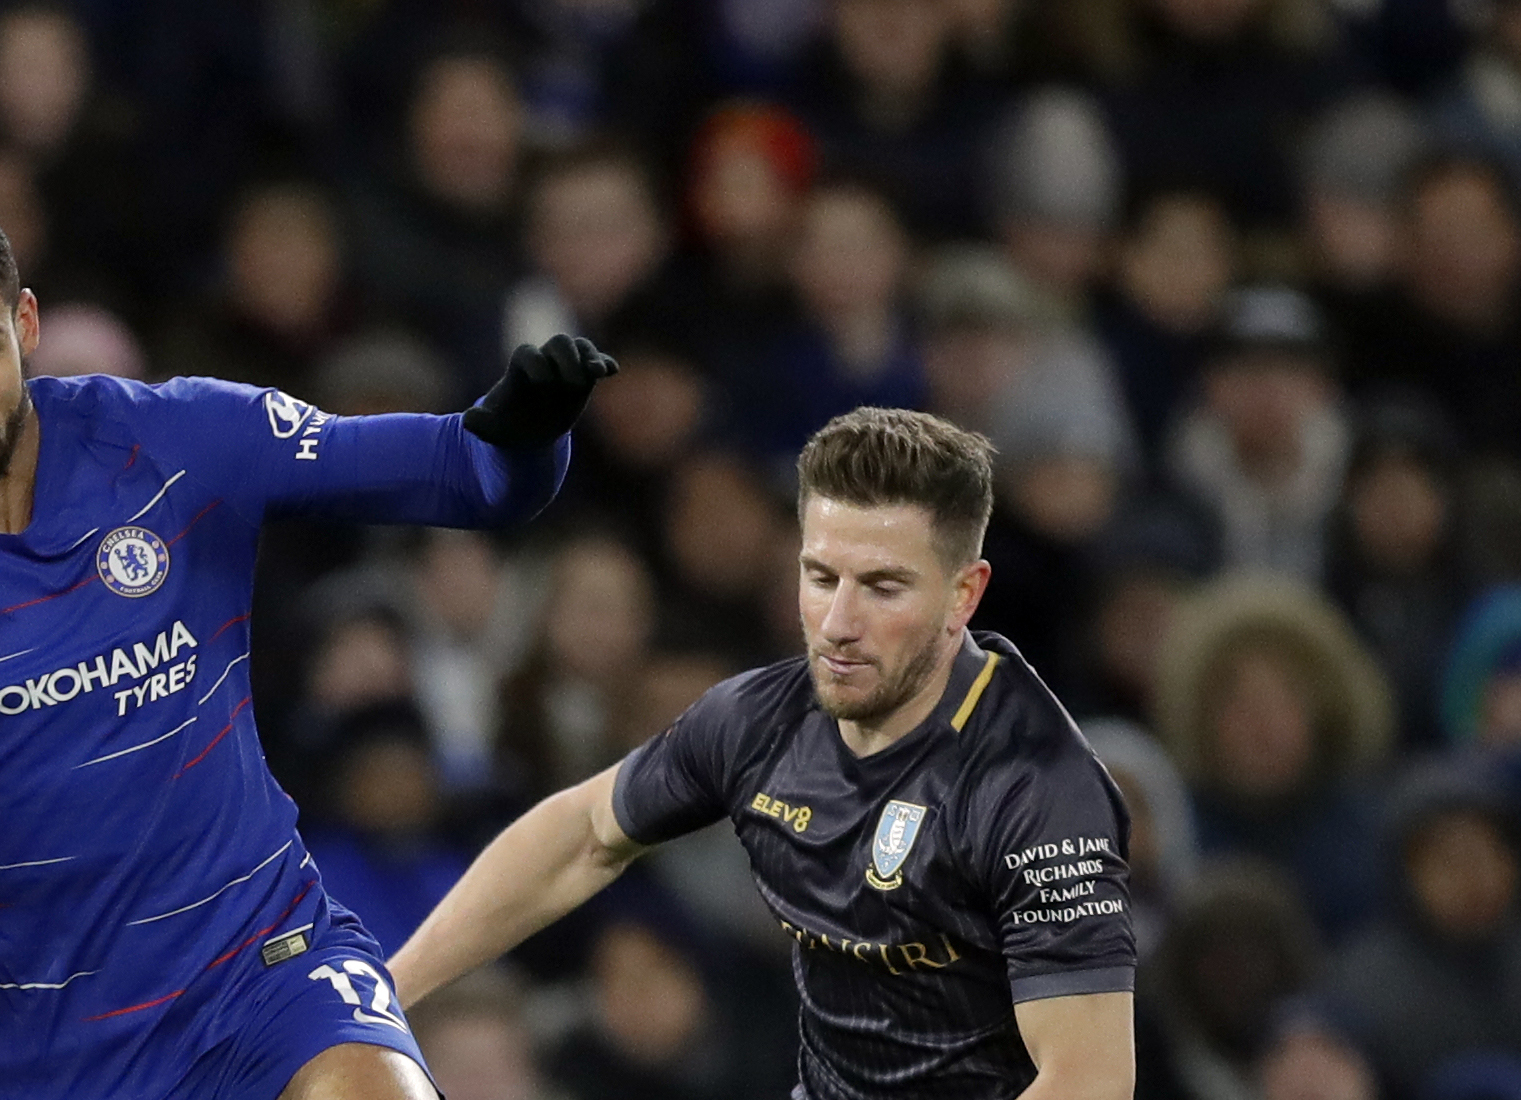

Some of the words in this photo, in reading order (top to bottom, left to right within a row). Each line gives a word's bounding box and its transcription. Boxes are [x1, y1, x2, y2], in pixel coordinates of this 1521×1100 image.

[102, 529, 144, 553] CHELSEA
[114, 654, 197, 717] TYRES
[751, 792, 812, 833] ELEV8
[1004, 843, 1059, 871] DAVID
[1061, 838, 1076, 856] &
[1078, 836, 1110, 857] JANE
[1023, 858, 1104, 888] RICHARDS
[1039, 879, 1096, 904] FAMILY
[1012, 898, 1124, 926] FOUNDATION
[307, 959, 409, 1032] 12
